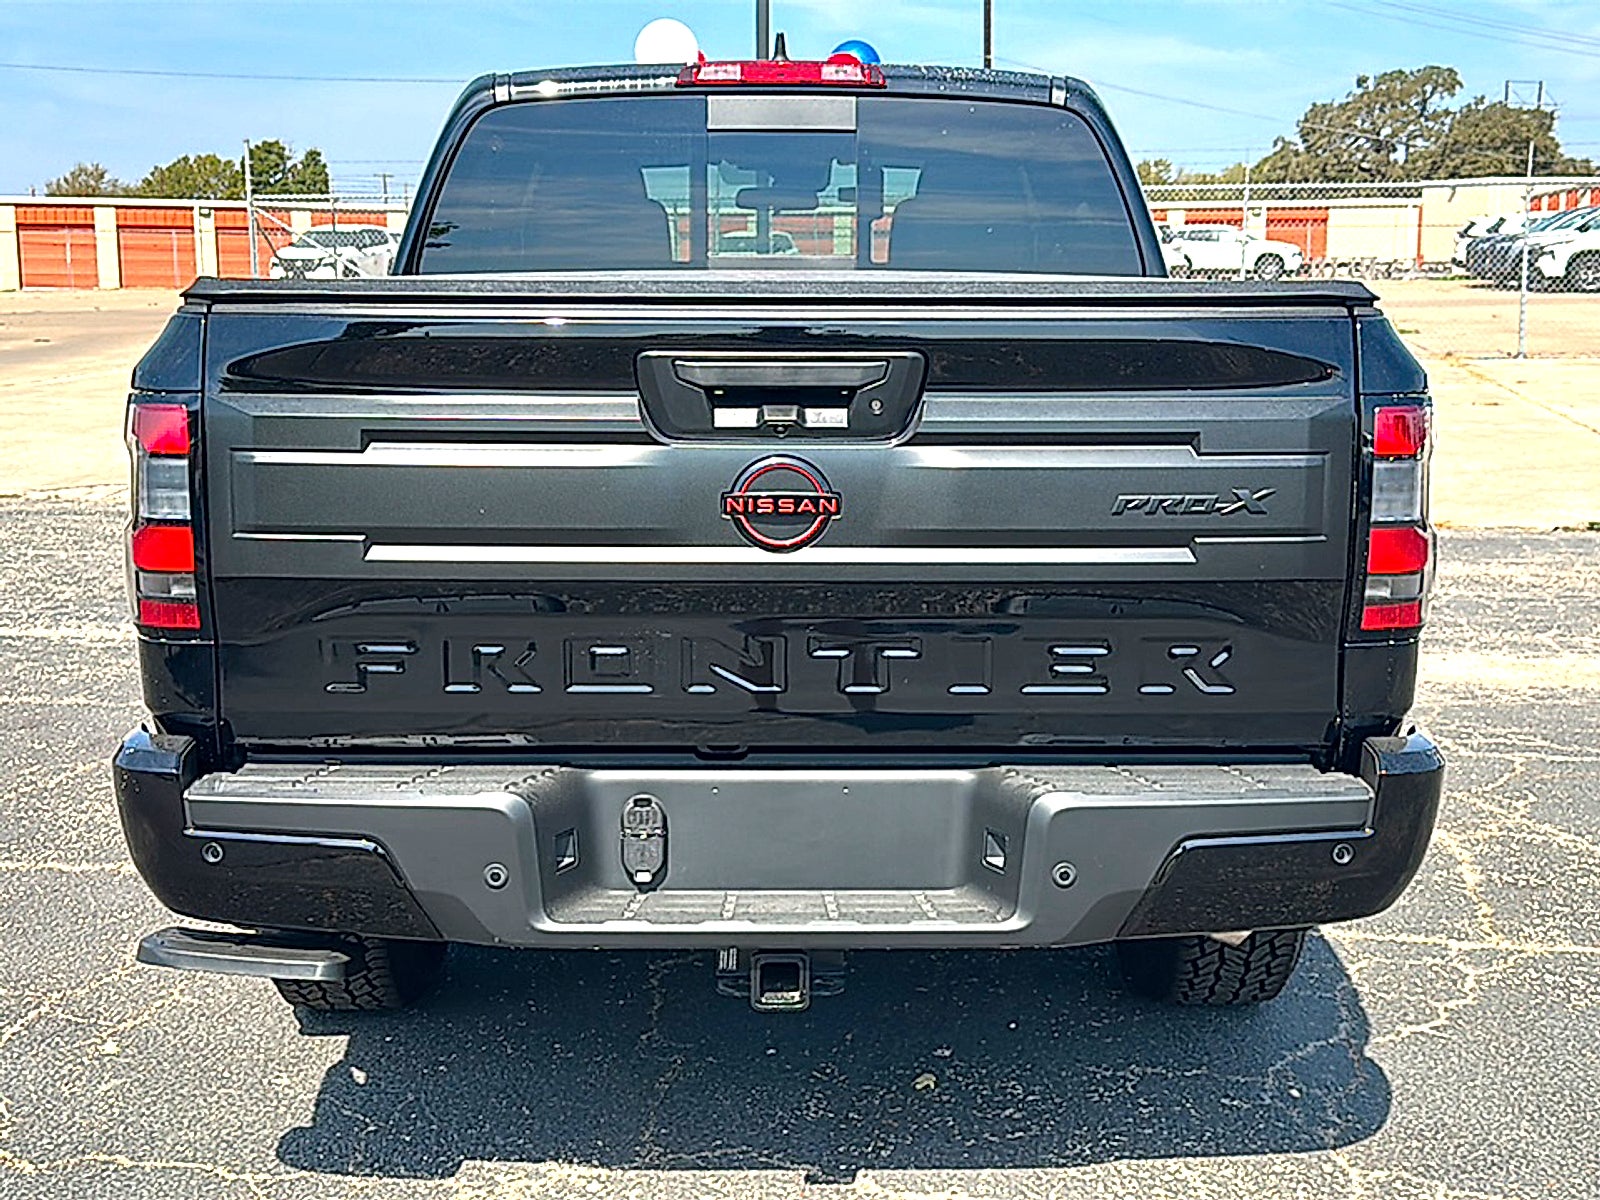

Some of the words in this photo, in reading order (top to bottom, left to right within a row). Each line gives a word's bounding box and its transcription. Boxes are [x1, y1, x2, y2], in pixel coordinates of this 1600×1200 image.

[725, 496, 839, 514] NISSAN
[1111, 487, 1277, 516] PRO-X
[319, 635, 1236, 694] FRONTIER
